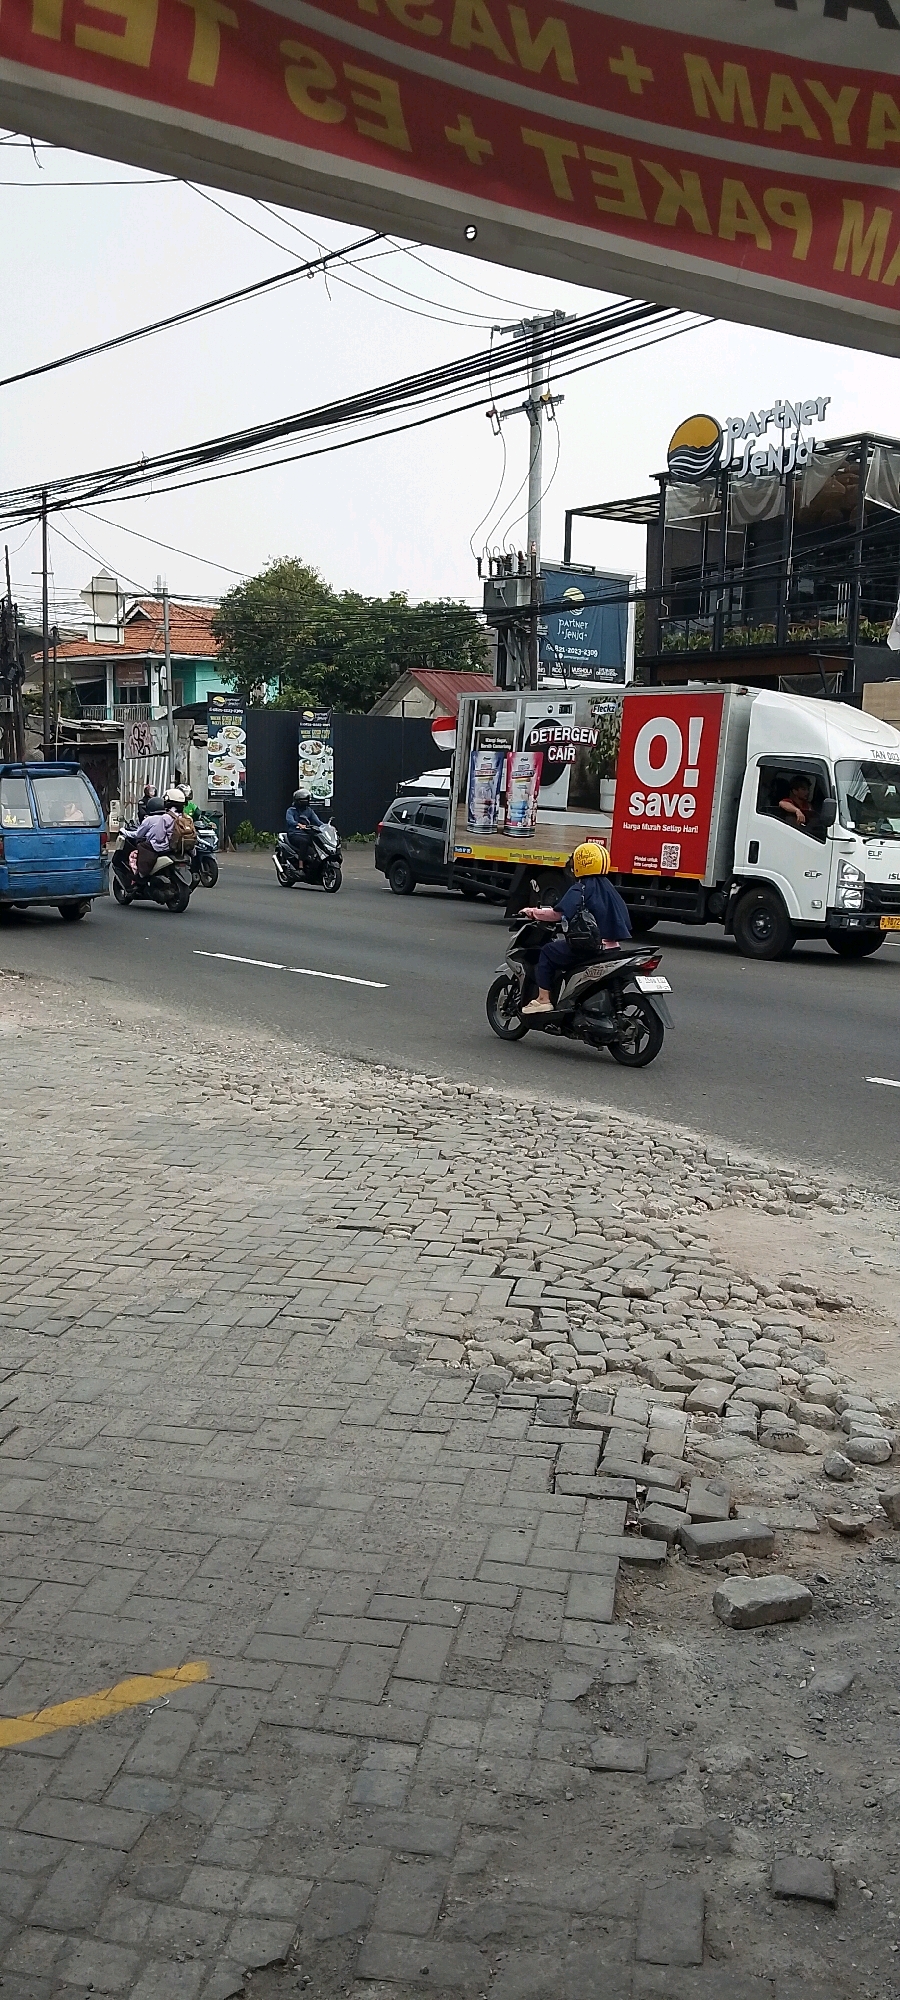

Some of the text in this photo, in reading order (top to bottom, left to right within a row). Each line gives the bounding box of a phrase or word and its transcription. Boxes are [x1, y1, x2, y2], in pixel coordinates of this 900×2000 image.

[592, 704, 616, 714] Fleckz
[530, 727, 599, 746] DETERGEN
[547, 747, 576, 763] CAIR
[634, 716, 704, 788] O!
[870, 750, 886, 759] TAN
[628, 791, 697, 818] save
[622, 822, 641, 831] Harga
[641, 823, 661, 831] Murah
[662, 824, 682, 833] Setiap
